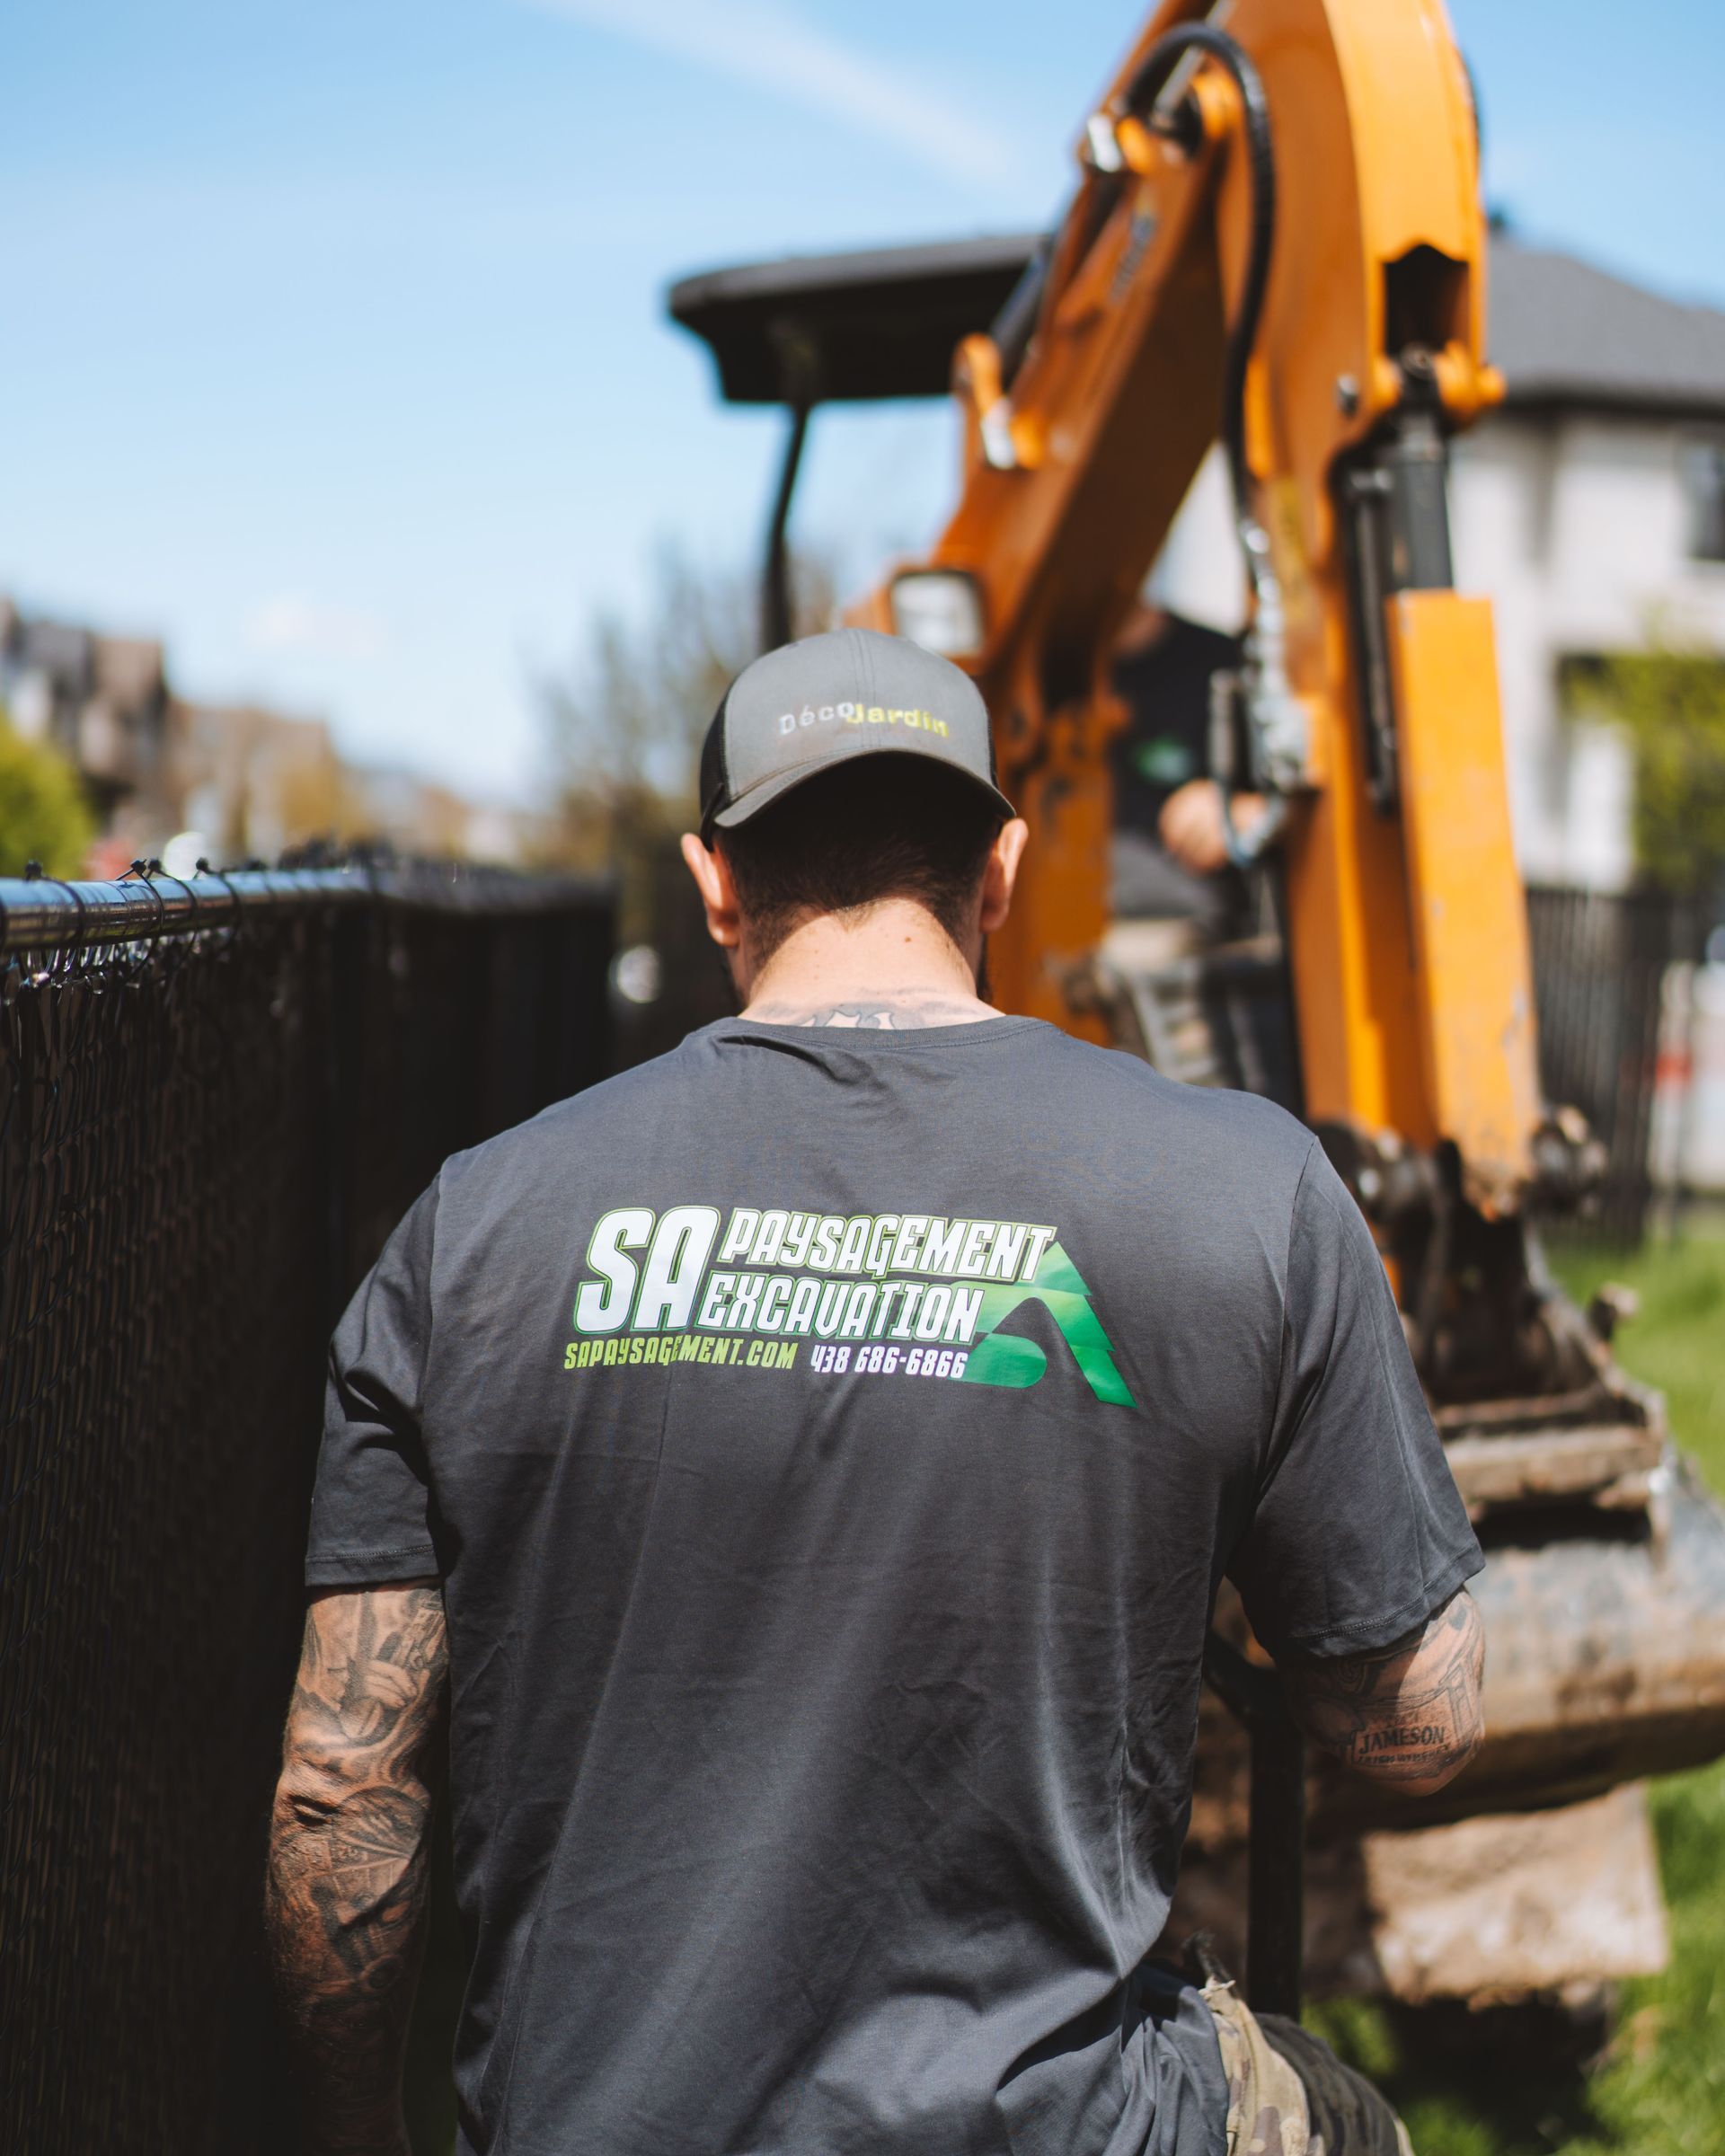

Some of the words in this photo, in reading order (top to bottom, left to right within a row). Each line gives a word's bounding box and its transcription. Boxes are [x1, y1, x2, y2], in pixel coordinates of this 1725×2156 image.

[573, 1205, 721, 1336] SA
[716, 1206, 1058, 1283] PAYSAGEMENT
[693, 1268, 986, 1346] EXCAVATION
[563, 1334, 799, 1370] SAPAYSAGEMENT.COM
[809, 1344, 852, 1374] 438
[854, 1346, 969, 1379] 686-6866
[1358, 1725, 1446, 1754] JAMESON
